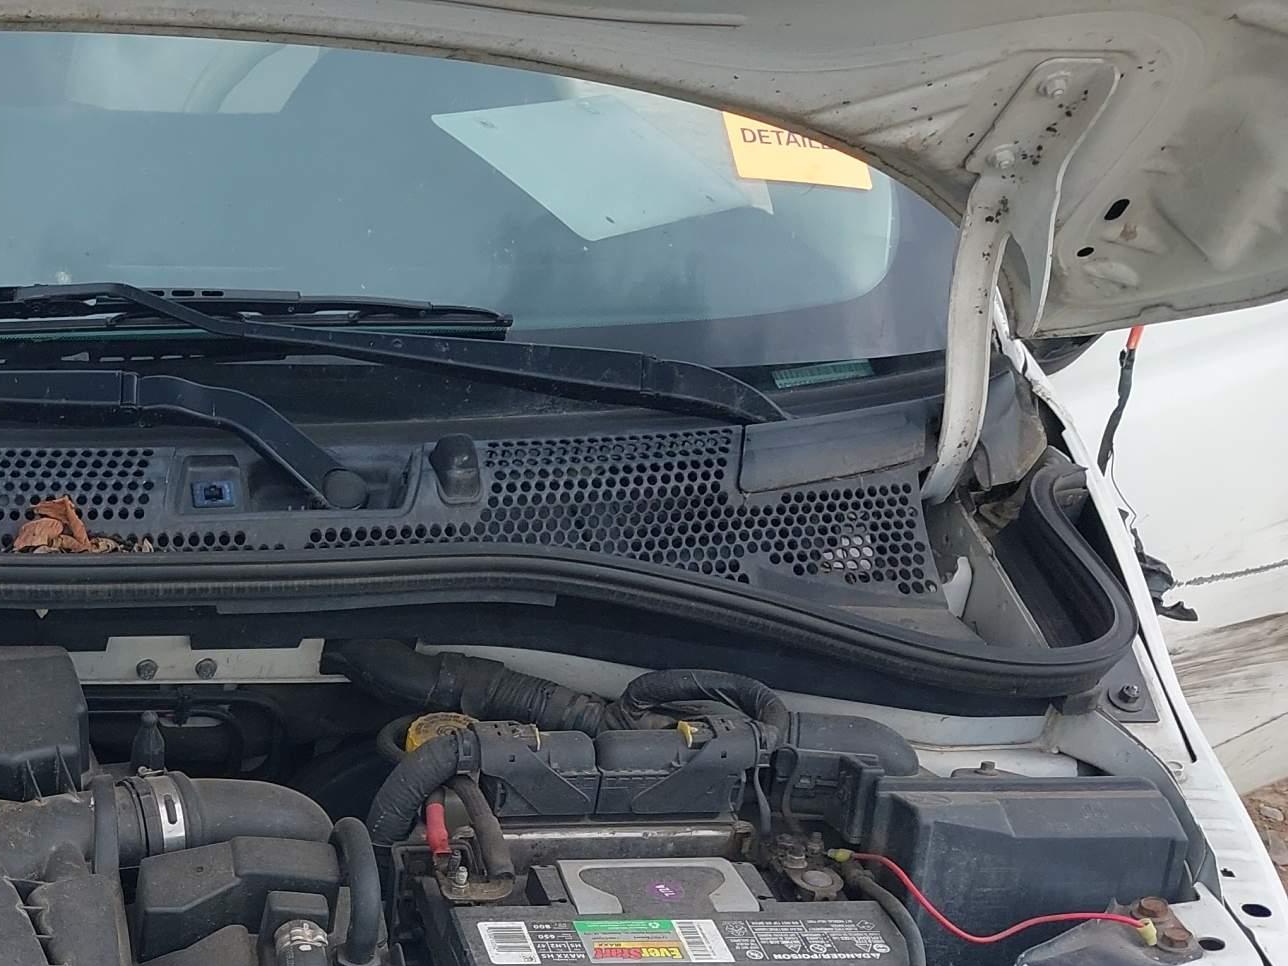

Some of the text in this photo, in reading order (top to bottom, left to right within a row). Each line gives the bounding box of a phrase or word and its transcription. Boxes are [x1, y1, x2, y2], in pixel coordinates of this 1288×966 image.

[740, 127, 834, 150] DETAIL
[593, 946, 682, 960] EverStart
[772, 952, 872, 961] DANGER/POISON
